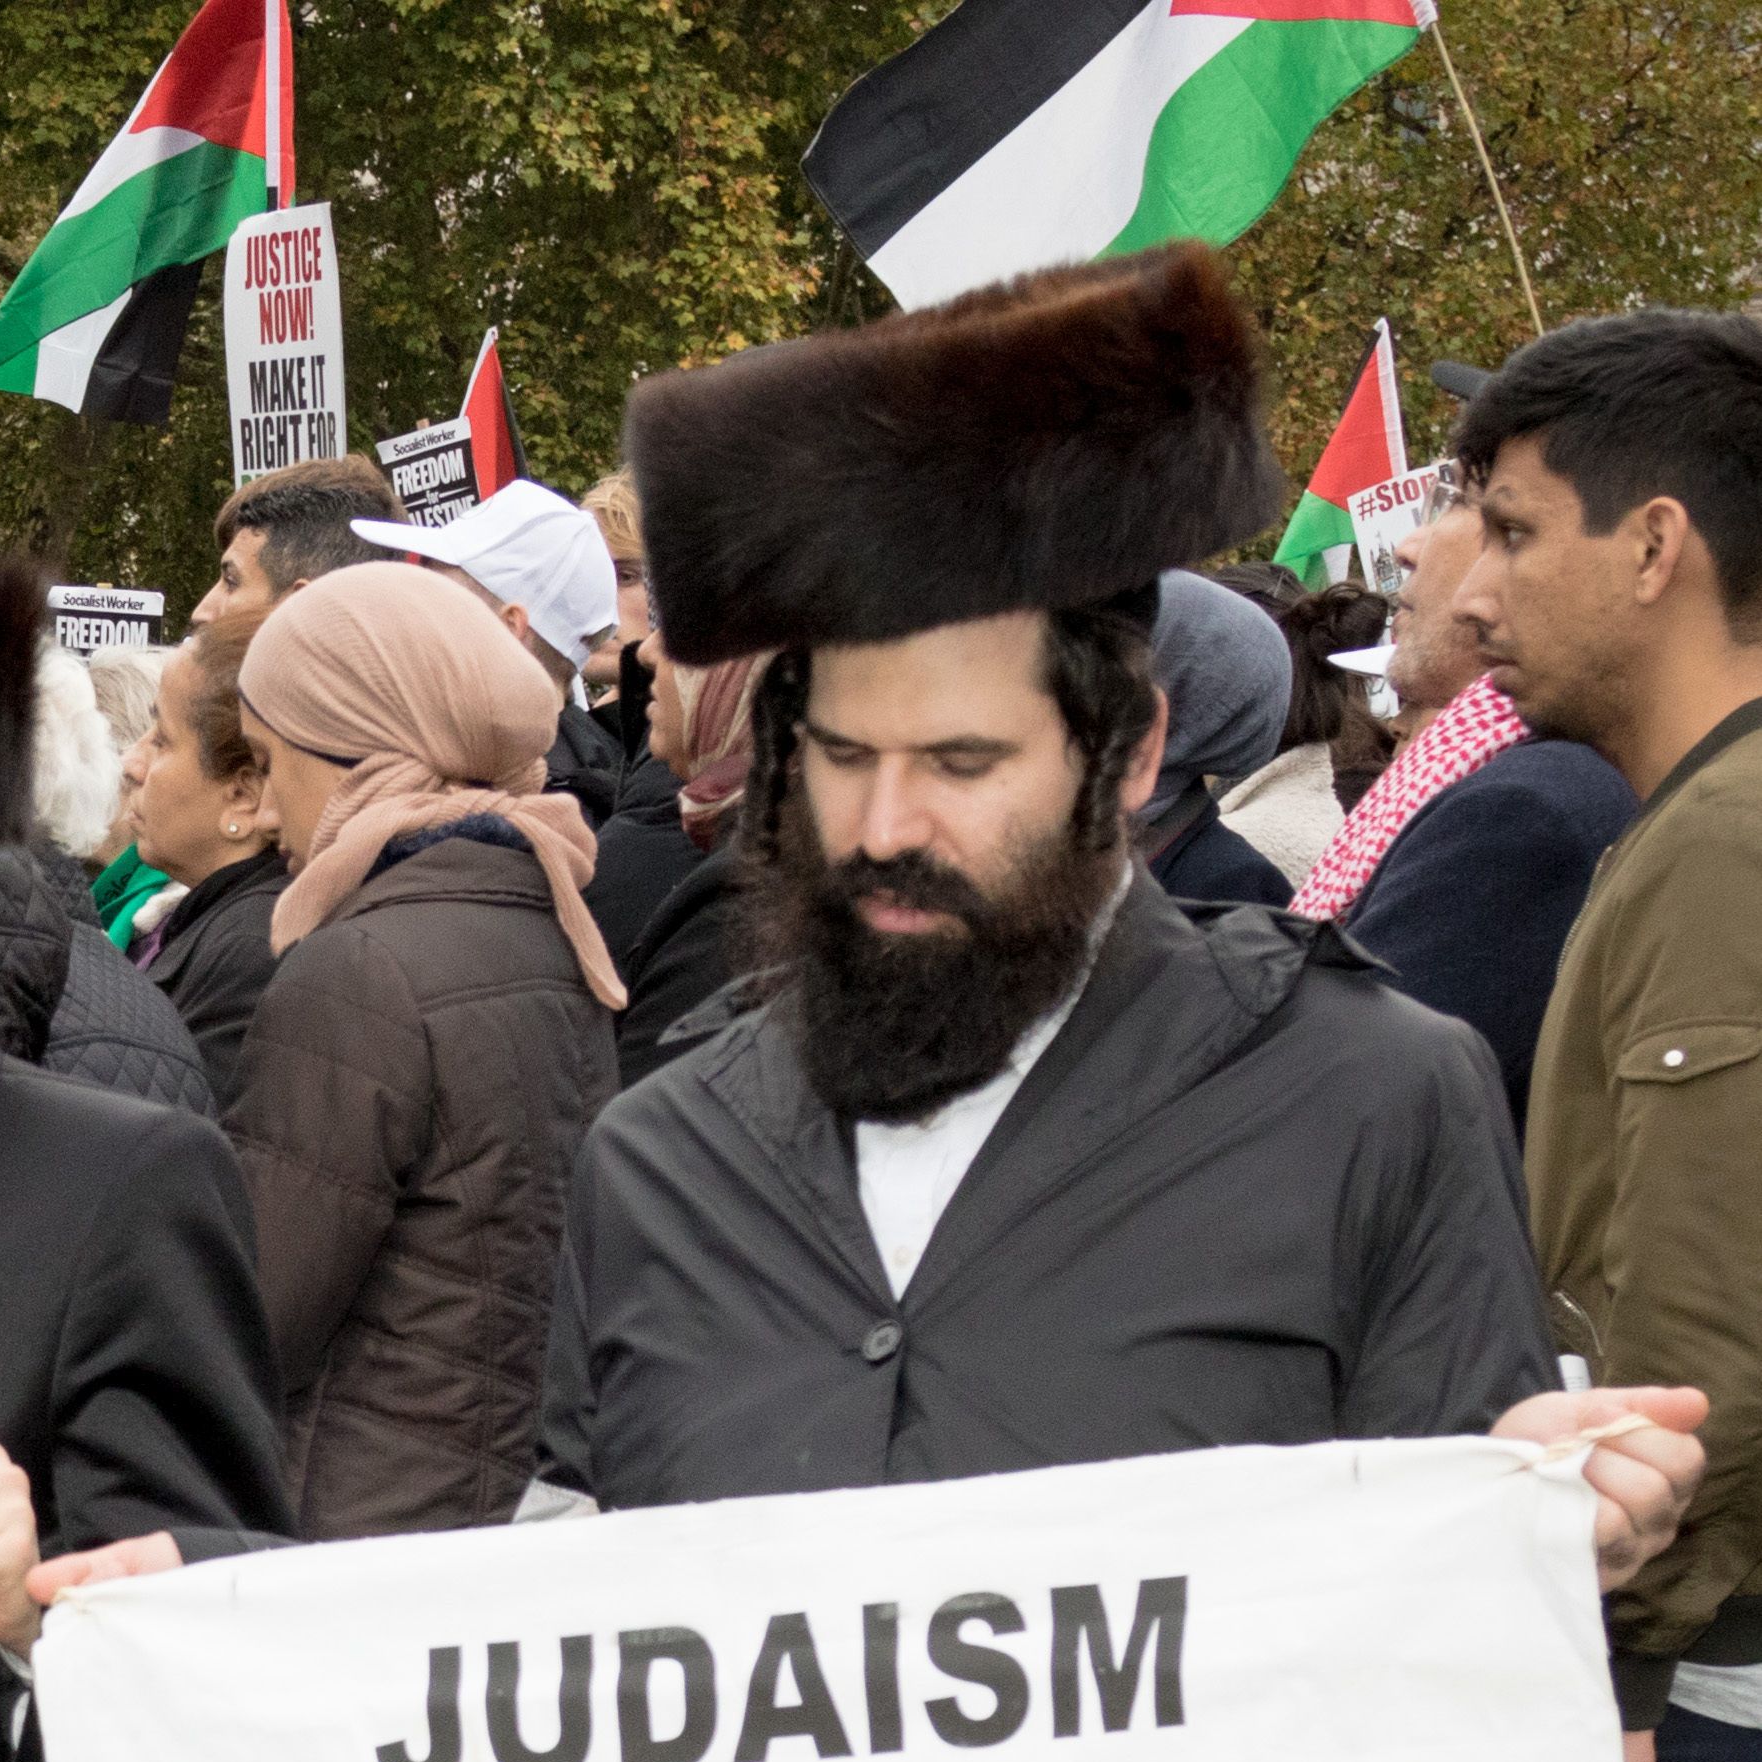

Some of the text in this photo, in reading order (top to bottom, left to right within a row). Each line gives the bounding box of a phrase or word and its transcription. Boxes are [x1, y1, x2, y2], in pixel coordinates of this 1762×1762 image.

[245, 227, 322, 290] JUSTICE
[259, 286, 314, 345] NOW!
[249, 354, 325, 414] MAKE IT
[240, 411, 337, 471] RIGHT FOR
[393, 428, 456, 457] Socialist Worker
[392, 448, 466, 496] FREEDOM
[408, 495, 475, 528] ALESTINE
[63, 593, 144, 611] Socialist Worker
[56, 615, 149, 649] FREEDOM
